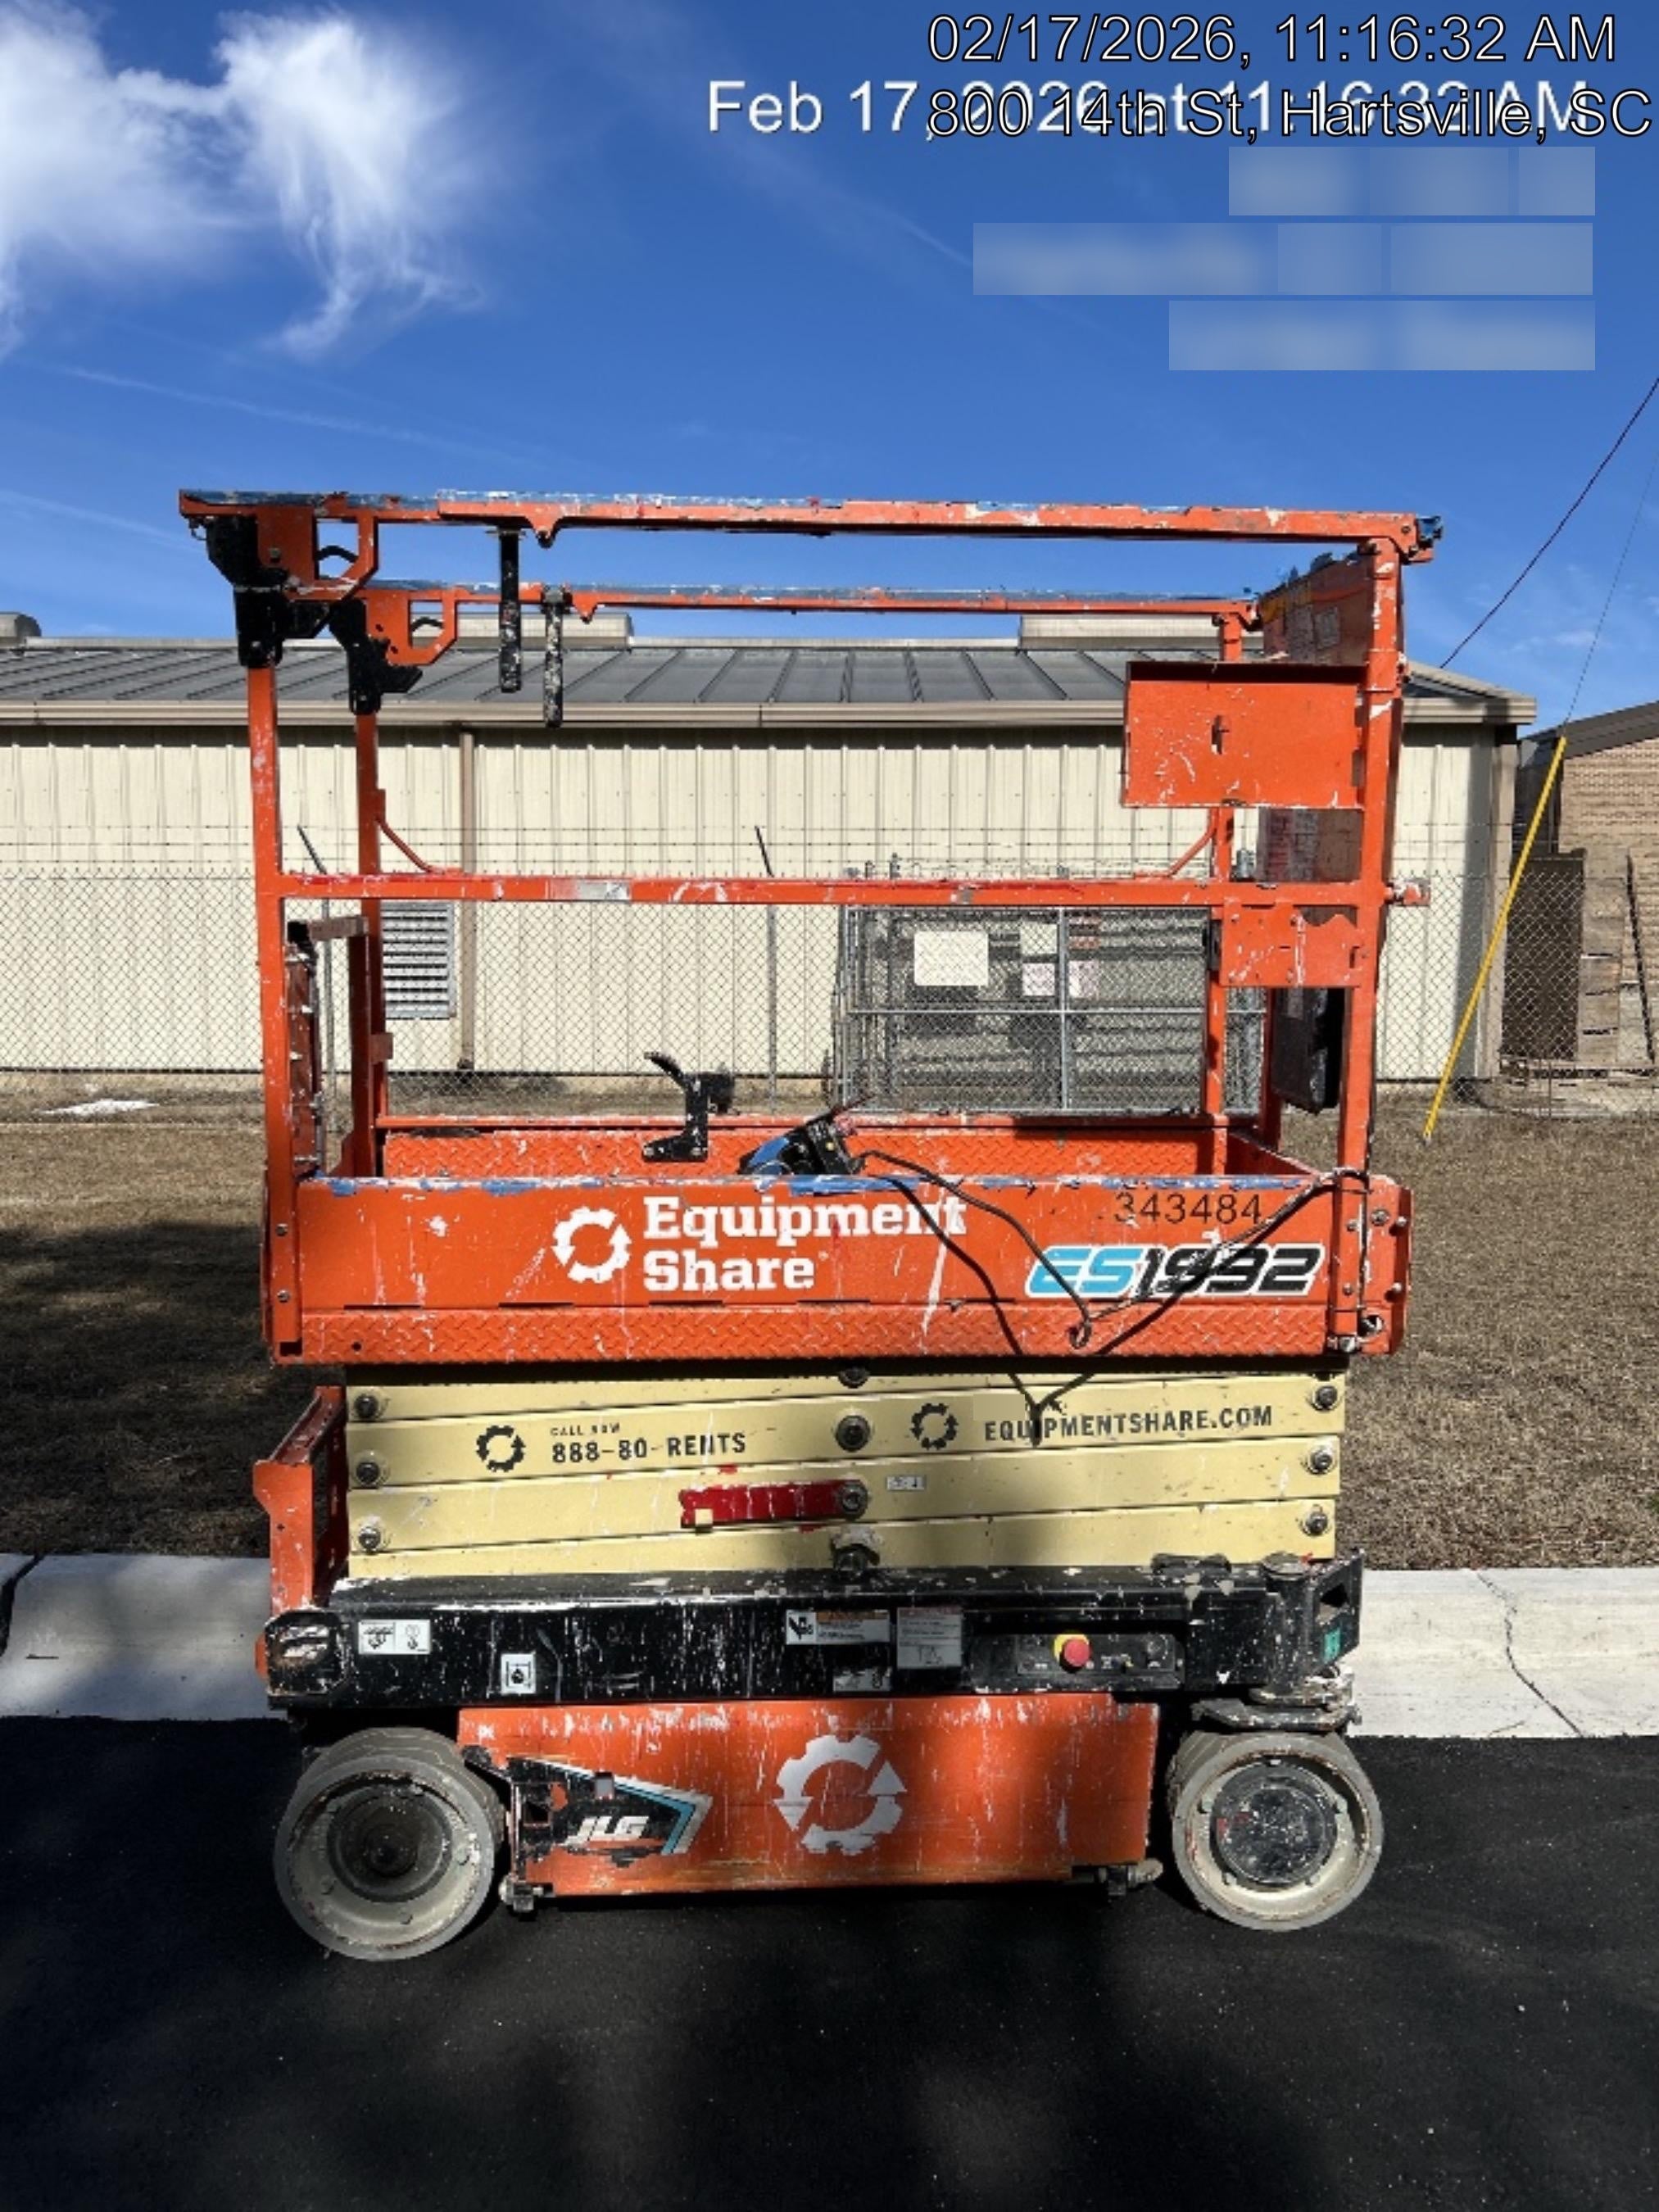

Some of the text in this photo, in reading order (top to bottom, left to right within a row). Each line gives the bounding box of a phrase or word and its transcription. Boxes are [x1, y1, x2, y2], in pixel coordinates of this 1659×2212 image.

[643, 1195, 967, 1247] Equipment
[1114, 1191, 1262, 1225] 343484
[643, 1250, 815, 1291] Share
[551, 1425, 584, 1437] CALL
[985, 1404, 1272, 1441] EQUPMENTSHARE.COM
[564, 1815, 650, 1847] JLG
